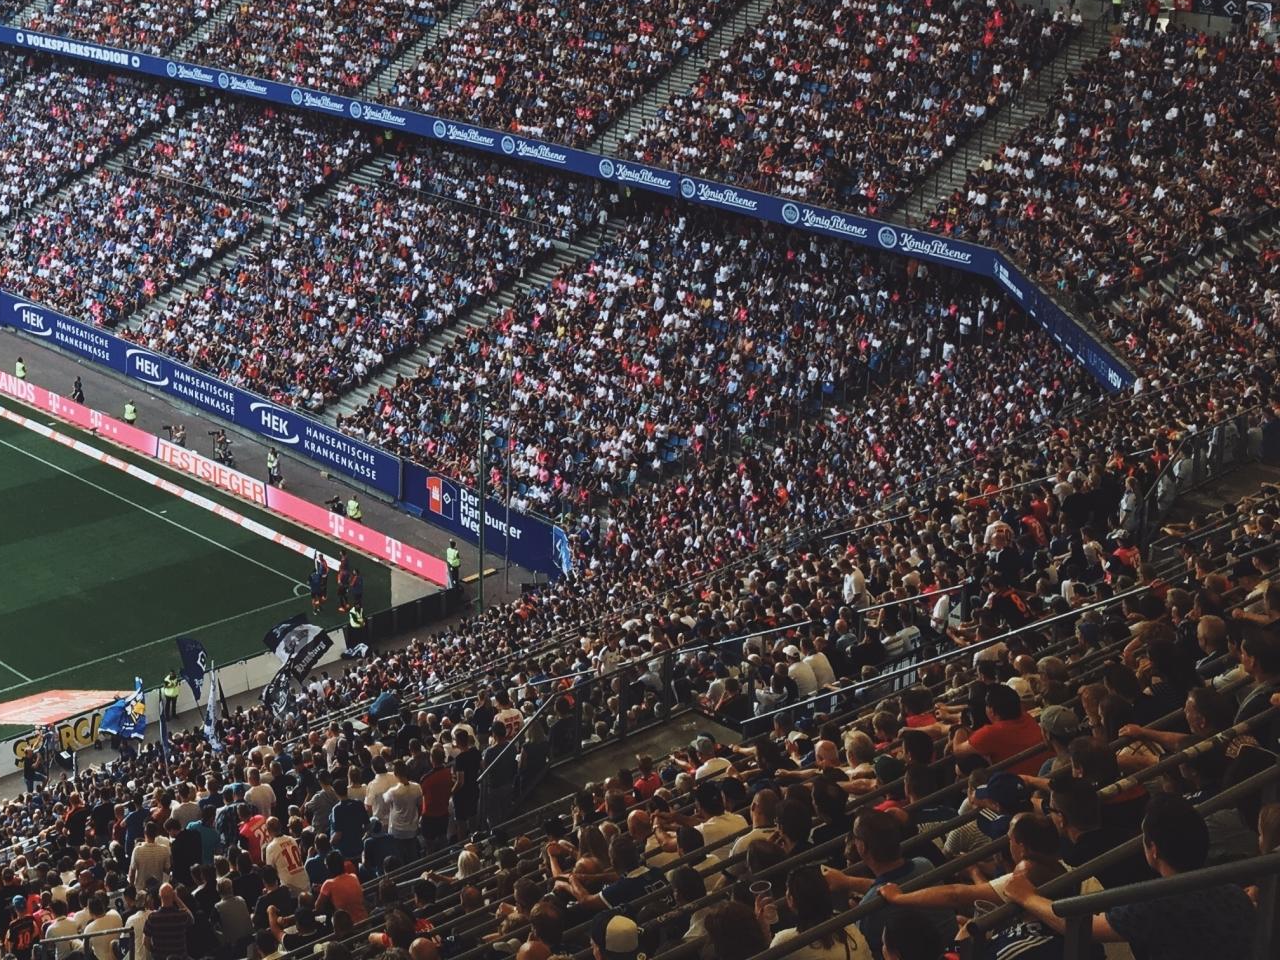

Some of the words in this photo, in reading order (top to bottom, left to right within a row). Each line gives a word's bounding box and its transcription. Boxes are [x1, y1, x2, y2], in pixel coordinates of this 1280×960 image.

[26, 34, 129, 66] VOLKSPARKSTADION
[615, 163, 642, 182] König
[639, 169, 672, 189] Pilsener
[697, 183, 725, 203] König
[722, 189, 757, 211] Pilsener
[801, 209, 832, 229] König
[829, 215, 868, 238] Pilsener
[899, 232, 931, 254] König
[928, 240, 972, 264] Pilsener
[22, 310, 44, 330] HEK
[56, 320, 109, 348] HANSEATISCHE
[55, 332, 110, 361] KRANKENKASSE
[135, 356, 160, 379] HEK
[172, 382, 235, 416] KRANKENKASSE
[174, 369, 234, 401] HANSEATISCHE
[261, 410, 289, 436] HEK
[304, 440, 377, 480] KRANKENKASSE
[306, 426, 375, 465] HANSEATISCHE
[159, 441, 265, 505] TESTSIEGER
[460, 488, 480, 507] Der
[281, 846, 304, 874] 10
